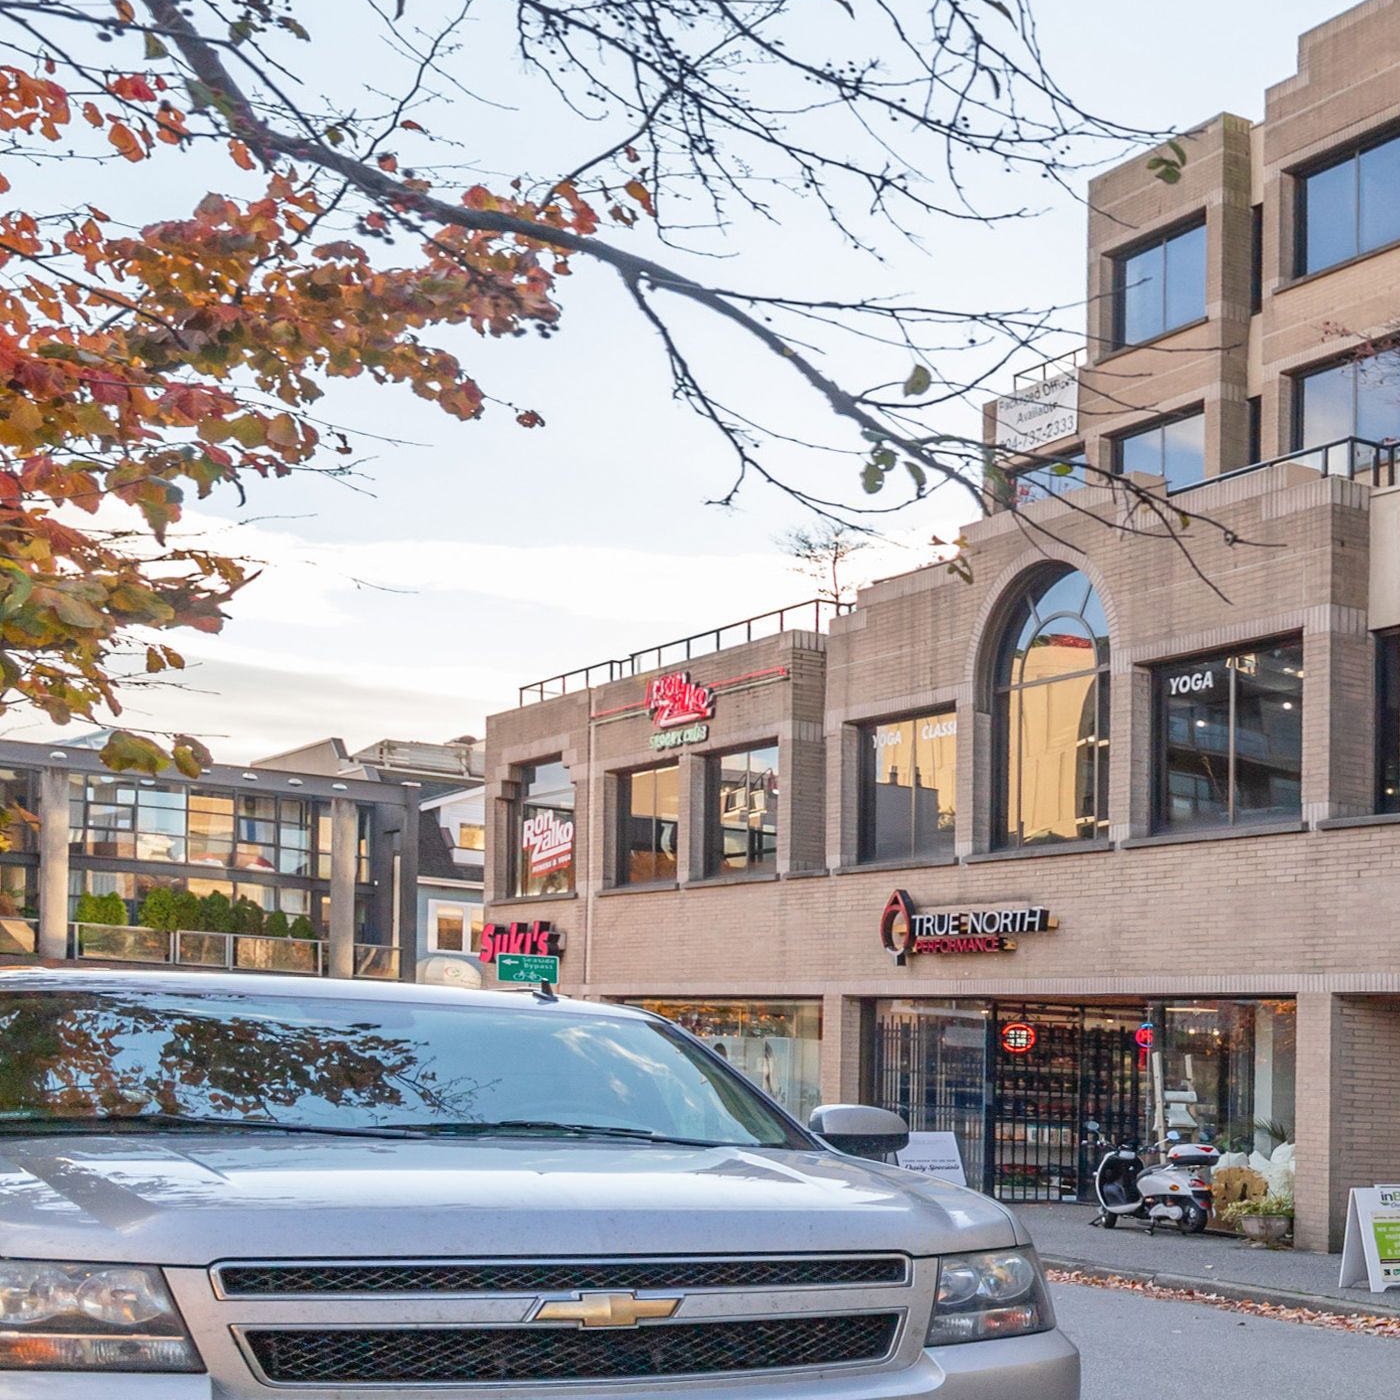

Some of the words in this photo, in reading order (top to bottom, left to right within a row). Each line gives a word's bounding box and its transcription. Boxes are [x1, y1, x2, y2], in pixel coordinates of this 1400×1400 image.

[999, 414, 1075, 449] 04-737-2333
[1169, 670, 1214, 696] YOGA
[872, 729, 902, 749] YOGA
[522, 809, 554, 849] Ron
[531, 819, 574, 863] Zalko
[911, 913, 961, 936] TRUE
[968, 906, 1042, 933] NORTH
[478, 920, 550, 964] Suki's
[915, 937, 1000, 954] PERFORMANCE
